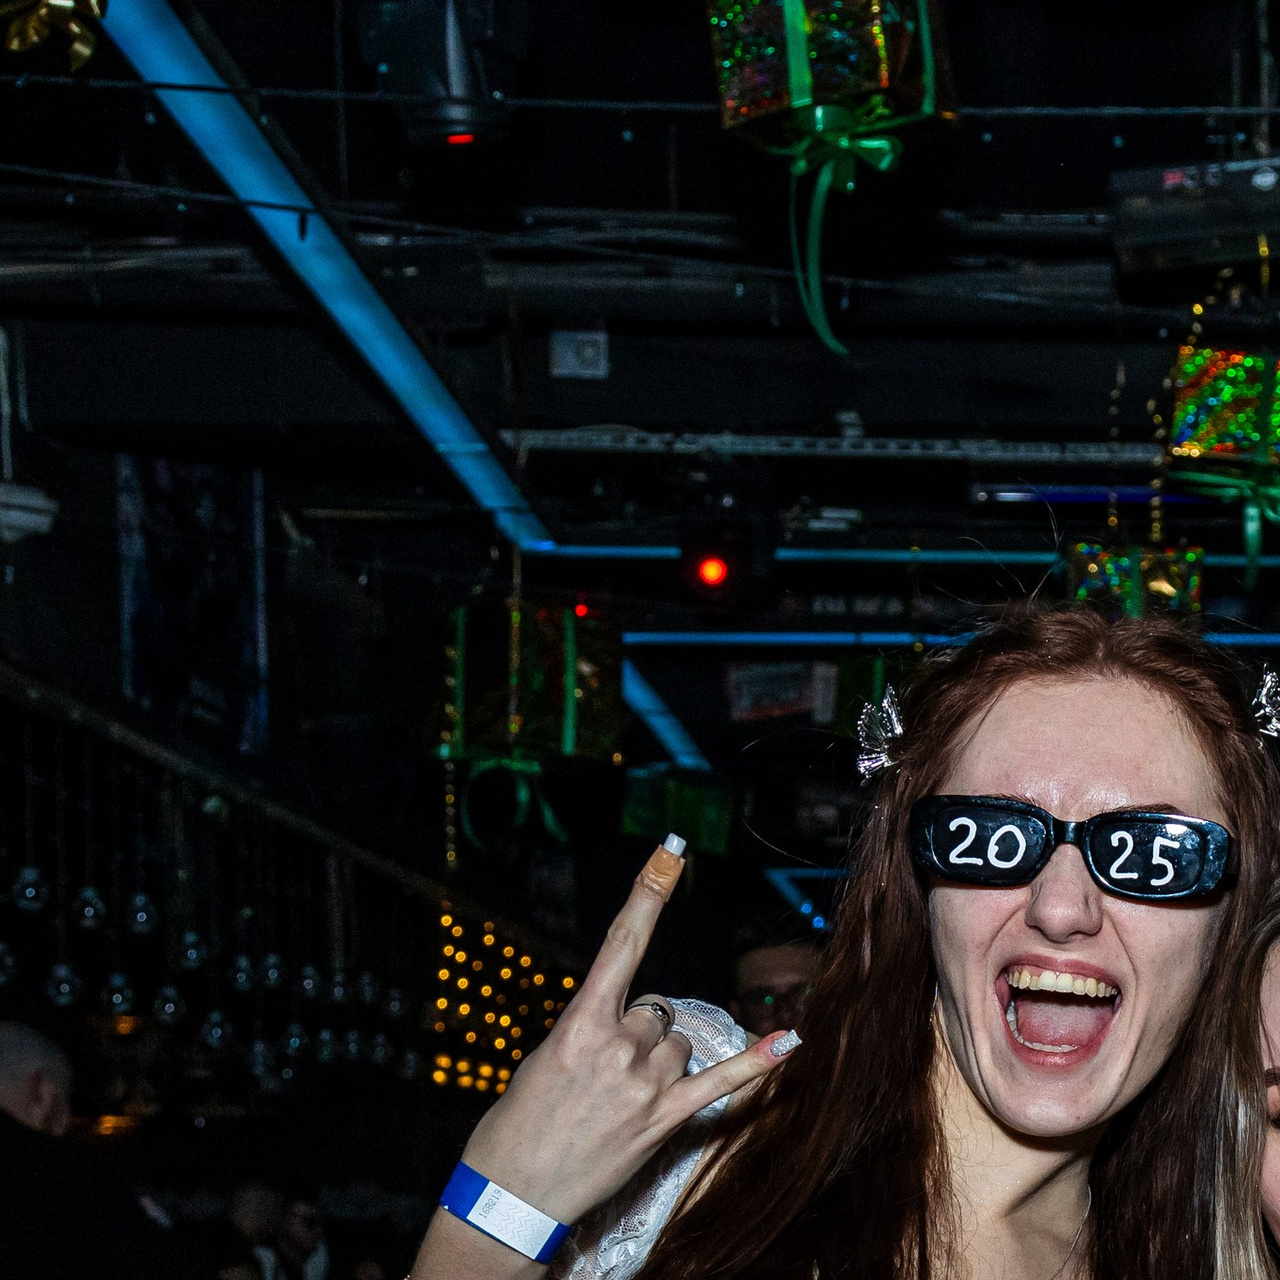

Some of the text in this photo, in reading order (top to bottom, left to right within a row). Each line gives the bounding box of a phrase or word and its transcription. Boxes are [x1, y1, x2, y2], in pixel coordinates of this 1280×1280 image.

[949, 816, 1180, 886] 20 25
[478, 1188, 503, 1219] 168219
